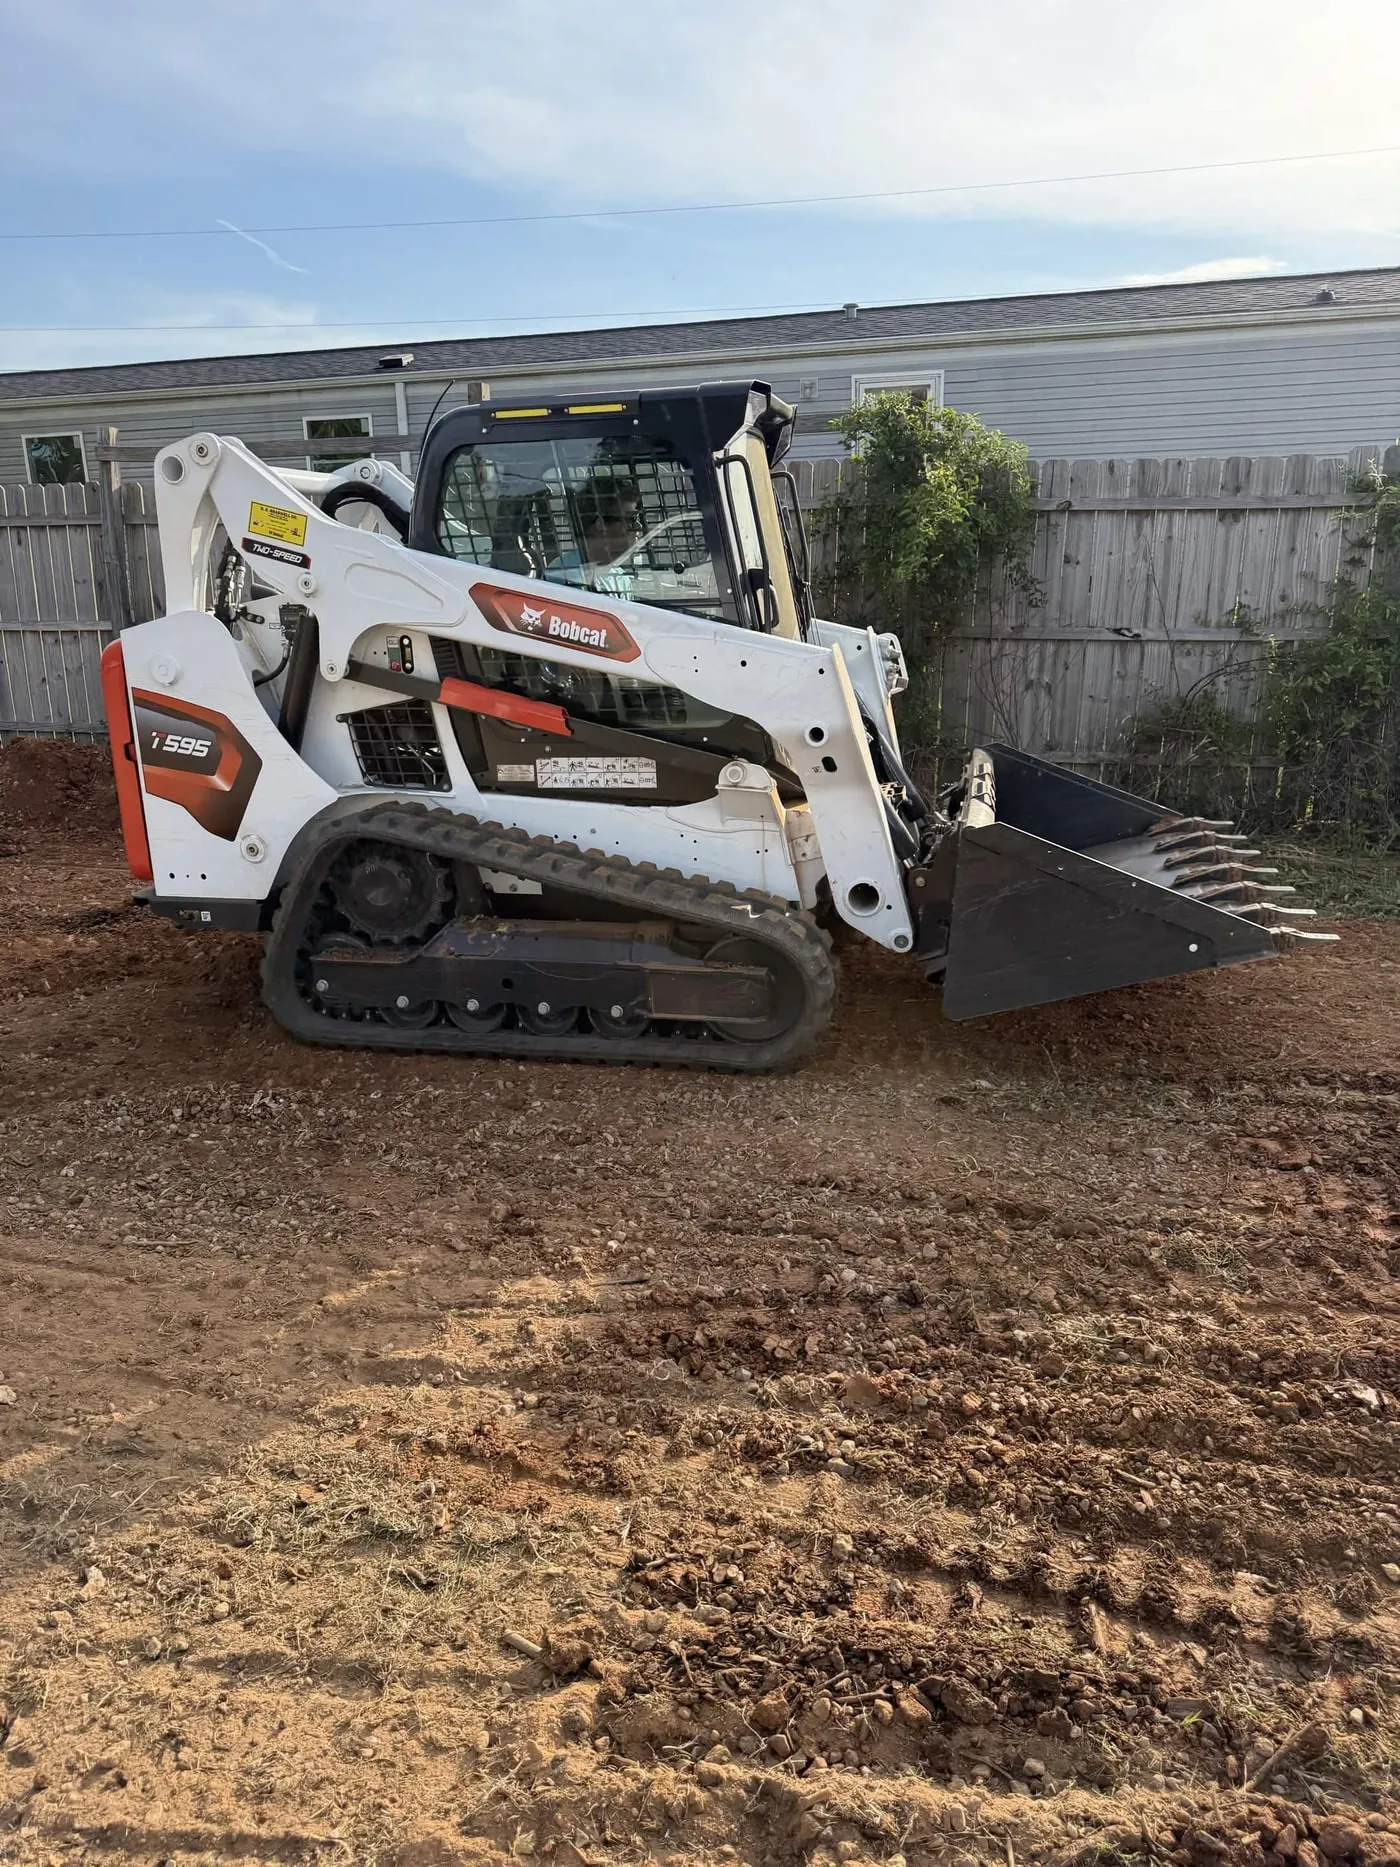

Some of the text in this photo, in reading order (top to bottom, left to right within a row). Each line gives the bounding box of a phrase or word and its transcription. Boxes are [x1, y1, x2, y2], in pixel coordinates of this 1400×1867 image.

[252, 543, 303, 564] TWO-SPEED
[548, 615, 607, 648] Bobcat
[151, 731, 212, 758] T595
